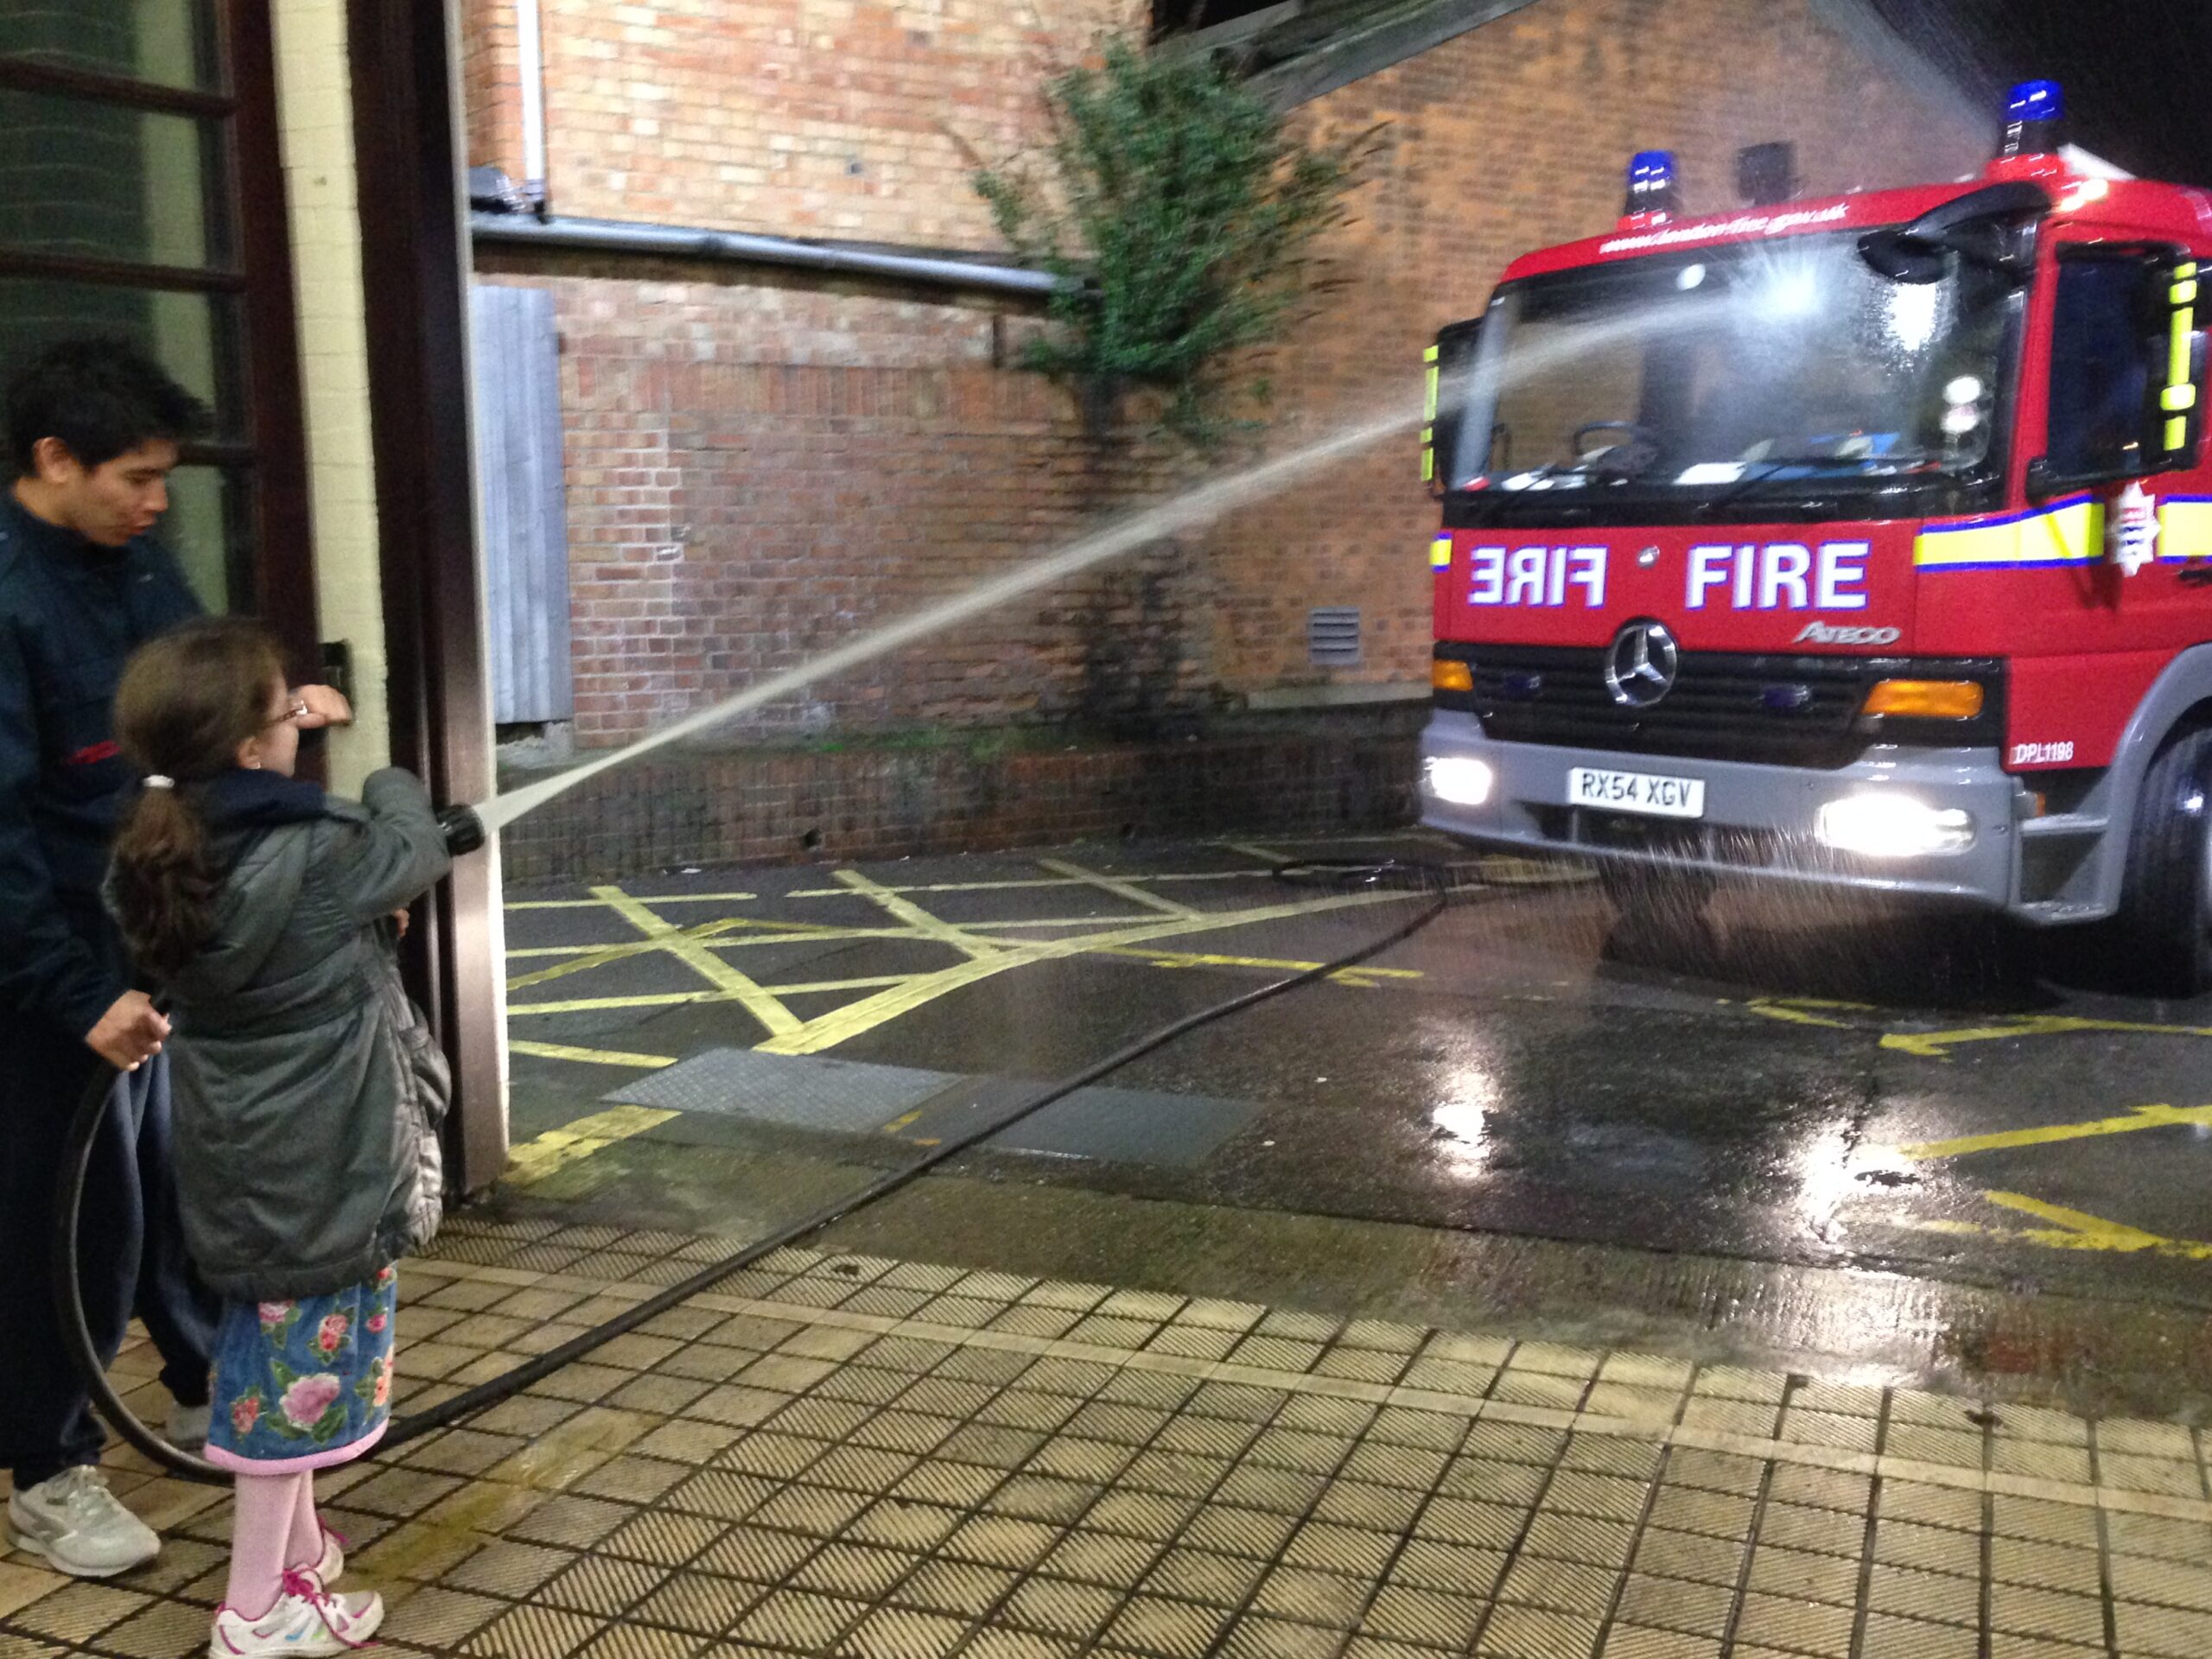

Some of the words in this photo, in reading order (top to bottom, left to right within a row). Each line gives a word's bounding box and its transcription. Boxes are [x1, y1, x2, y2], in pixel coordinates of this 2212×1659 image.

[1685, 539, 1871, 610] FIRE
[1582, 772, 1638, 801] RX54
[1646, 778, 1691, 807] XGV
